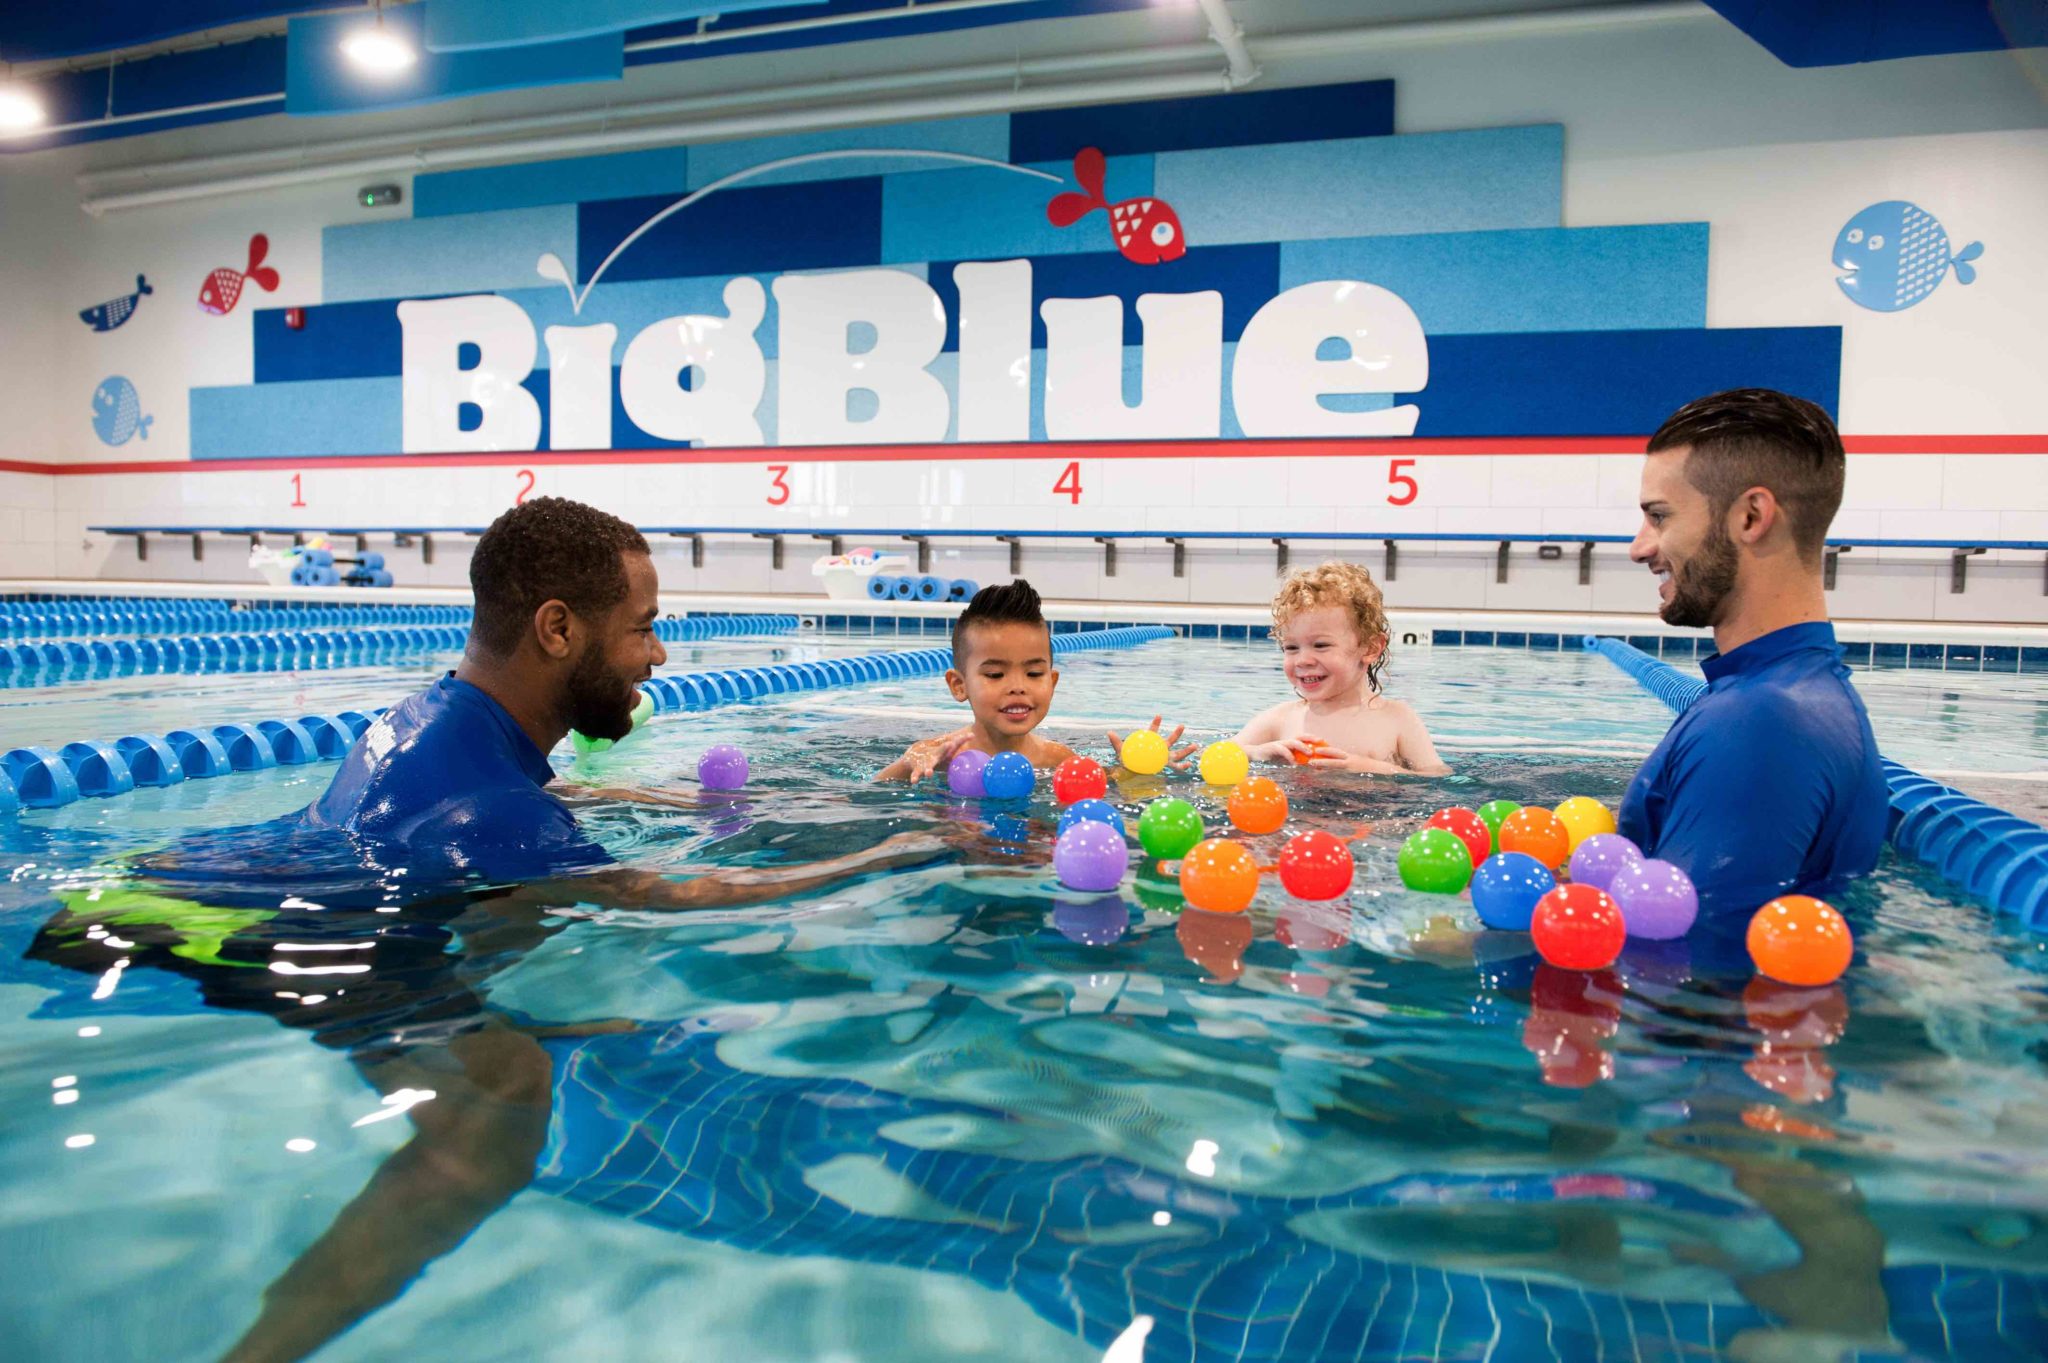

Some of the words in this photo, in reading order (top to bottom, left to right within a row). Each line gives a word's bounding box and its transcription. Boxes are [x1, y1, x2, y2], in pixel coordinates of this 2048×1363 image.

[291, 473, 305, 509] 1
[515, 468, 536, 507] 2
[767, 464, 791, 507] 3
[1051, 460, 1084, 506] 4
[1386, 458, 1419, 507] 5
